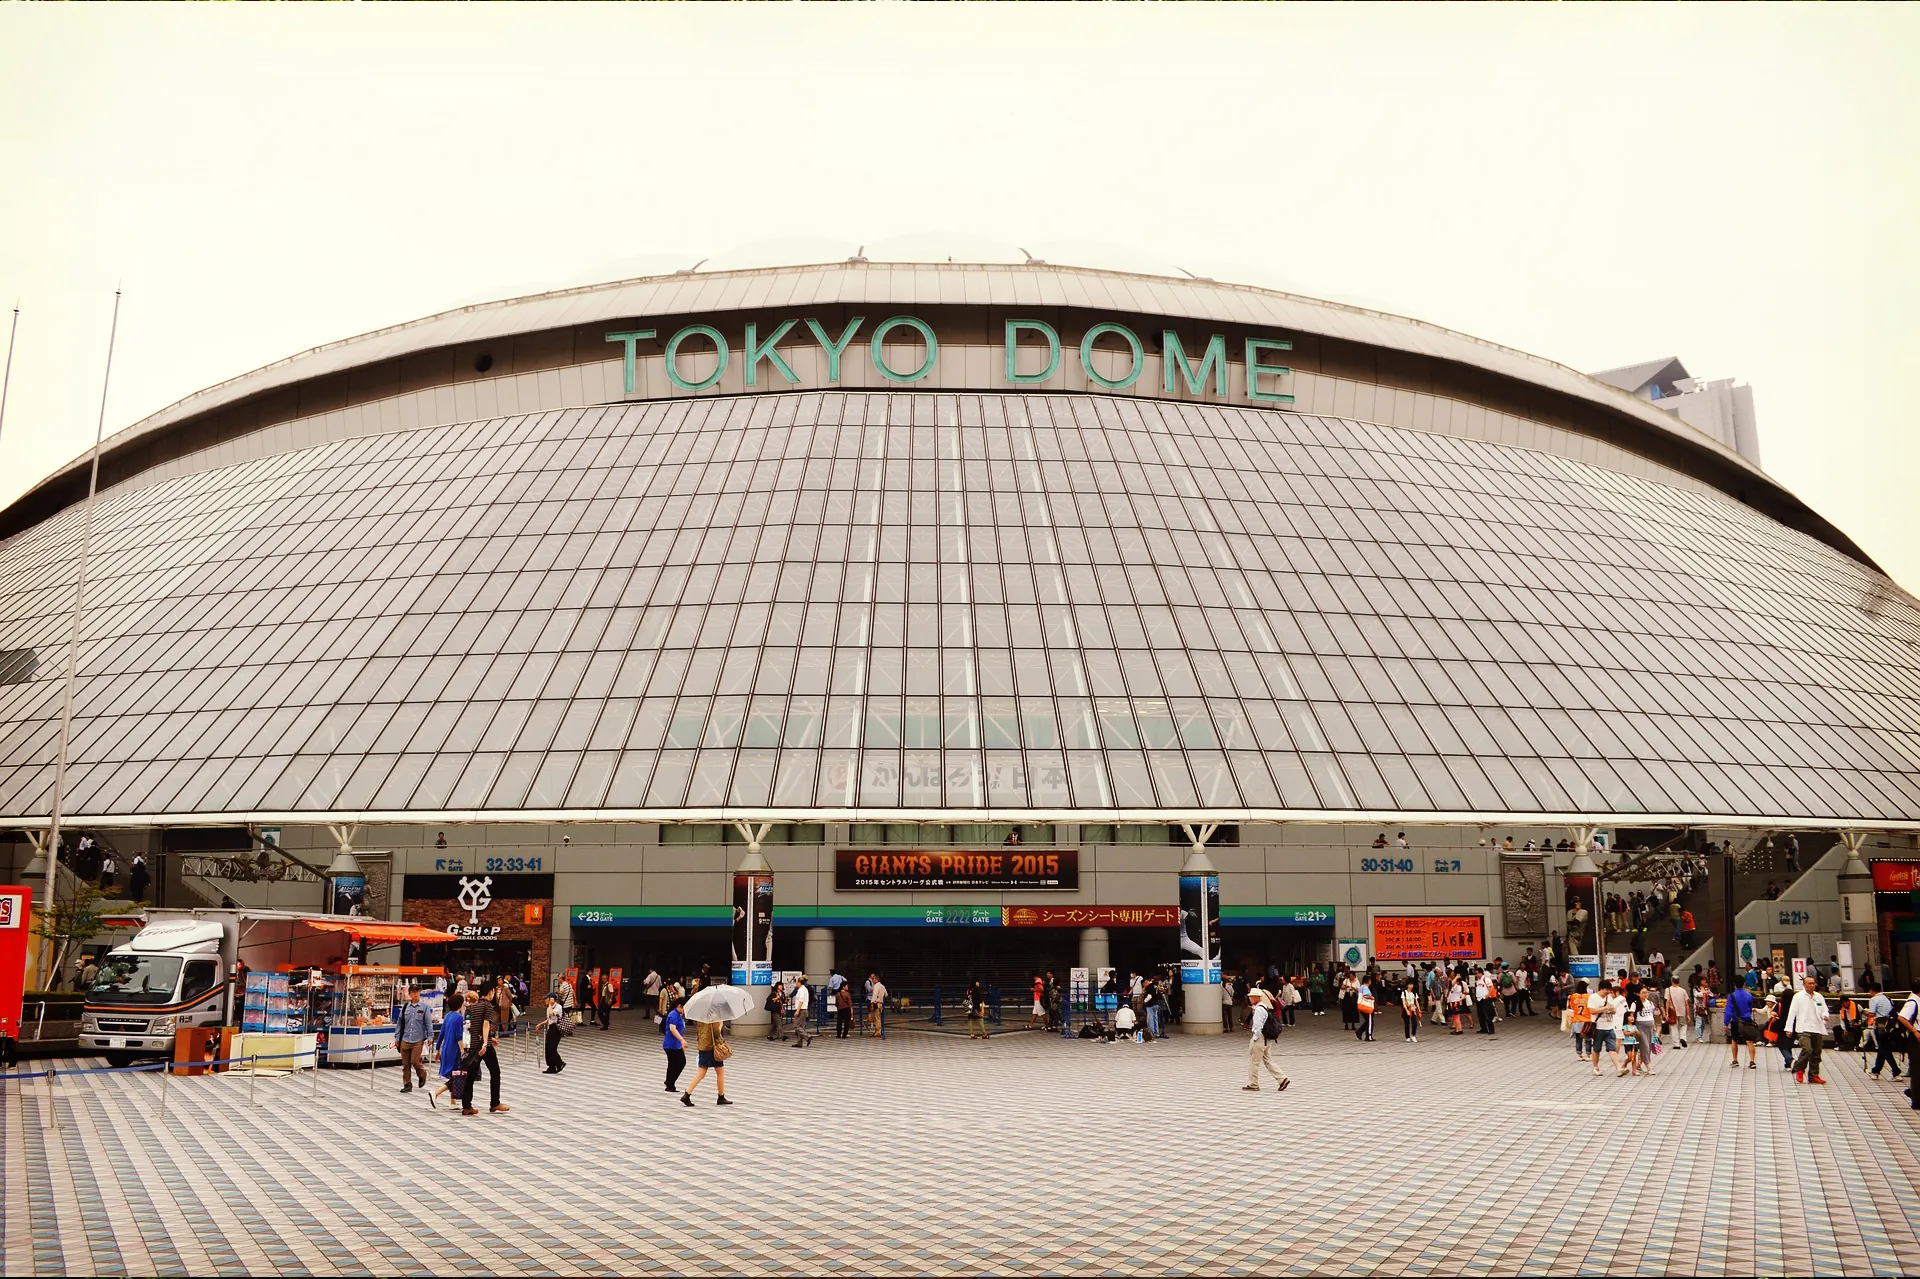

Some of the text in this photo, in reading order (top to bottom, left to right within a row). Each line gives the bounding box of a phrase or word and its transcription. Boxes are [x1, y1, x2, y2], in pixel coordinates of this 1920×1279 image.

[605, 316, 1295, 404] TOKYO DOME
[856, 855, 1059, 875] GIANTS PRIDE 2015
[586, 911, 600, 922] 23
[1042, 909, 1175, 923] シーズンシート専用ゲート
[1308, 911, 1320, 921] 21
[1791, 911, 1801, 924] 21
[1578, 1005, 1585, 1016] 7
